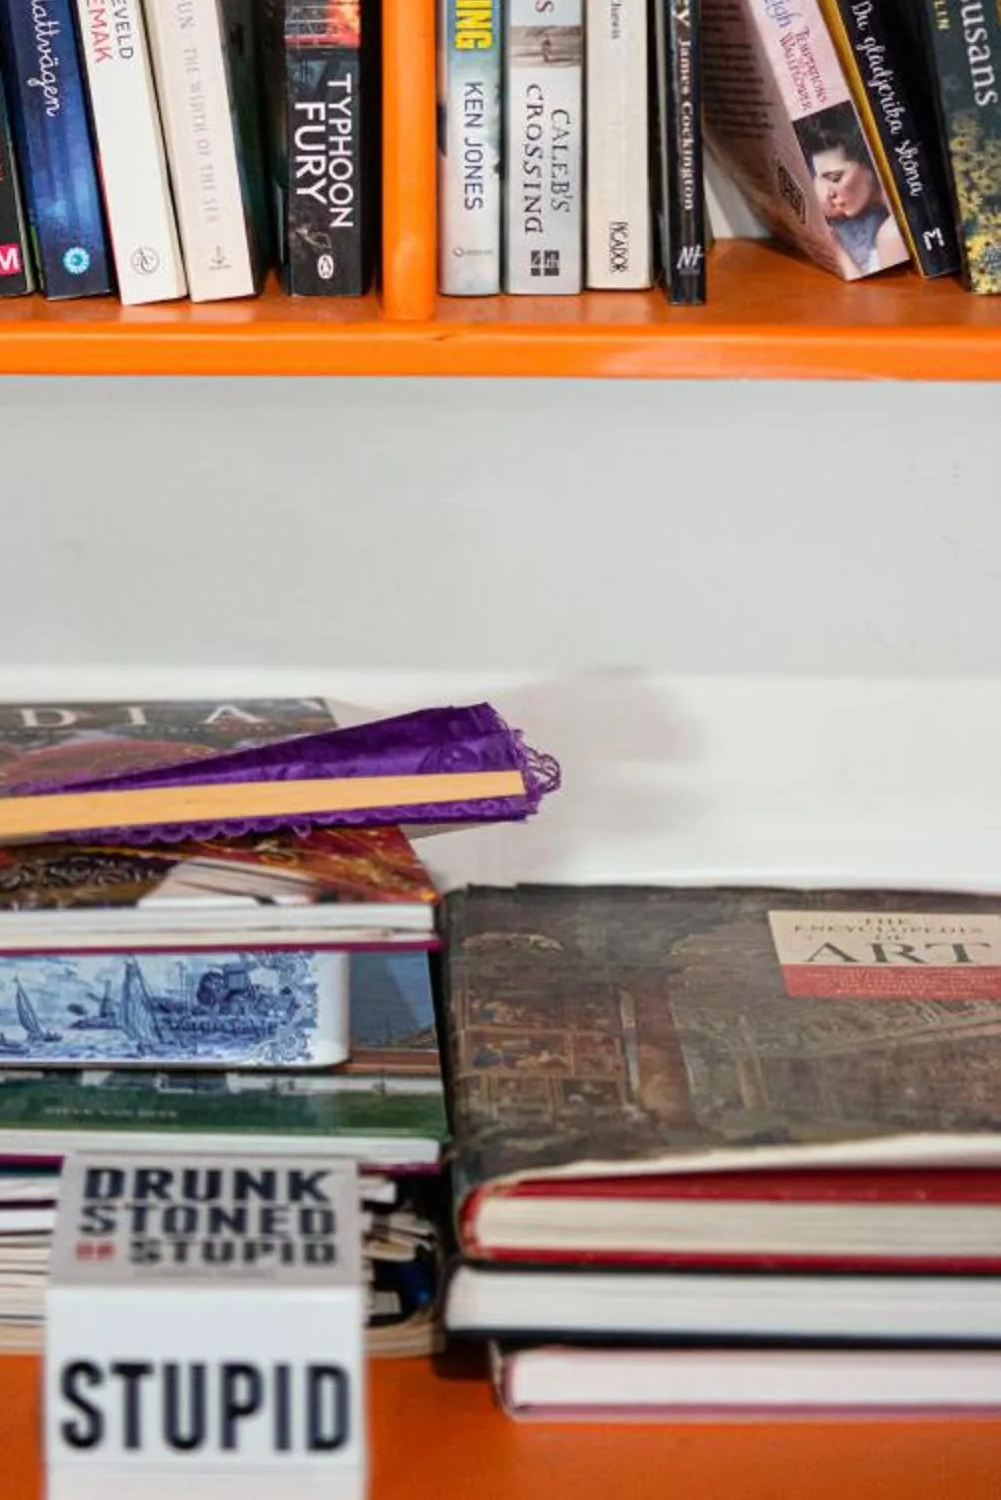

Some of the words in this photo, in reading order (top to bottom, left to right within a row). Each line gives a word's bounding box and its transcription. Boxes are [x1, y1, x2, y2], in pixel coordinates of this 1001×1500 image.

[678, 38, 693, 95] James
[464, 81, 484, 129] KEN
[295, 102, 328, 205] FURY
[327, 73, 354, 228] TYPHOON
[464, 140, 484, 211] JONES
[523, 83, 545, 234] CROSSING
[550, 108, 575, 213] CALEB'S
[806, 942, 993, 964] ART
[84, 1167, 333, 1202] DRUNK
[79, 1203, 337, 1236] STONED
[129, 1238, 337, 1265] STUPID
[60, 1360, 351, 1453] STUPID
